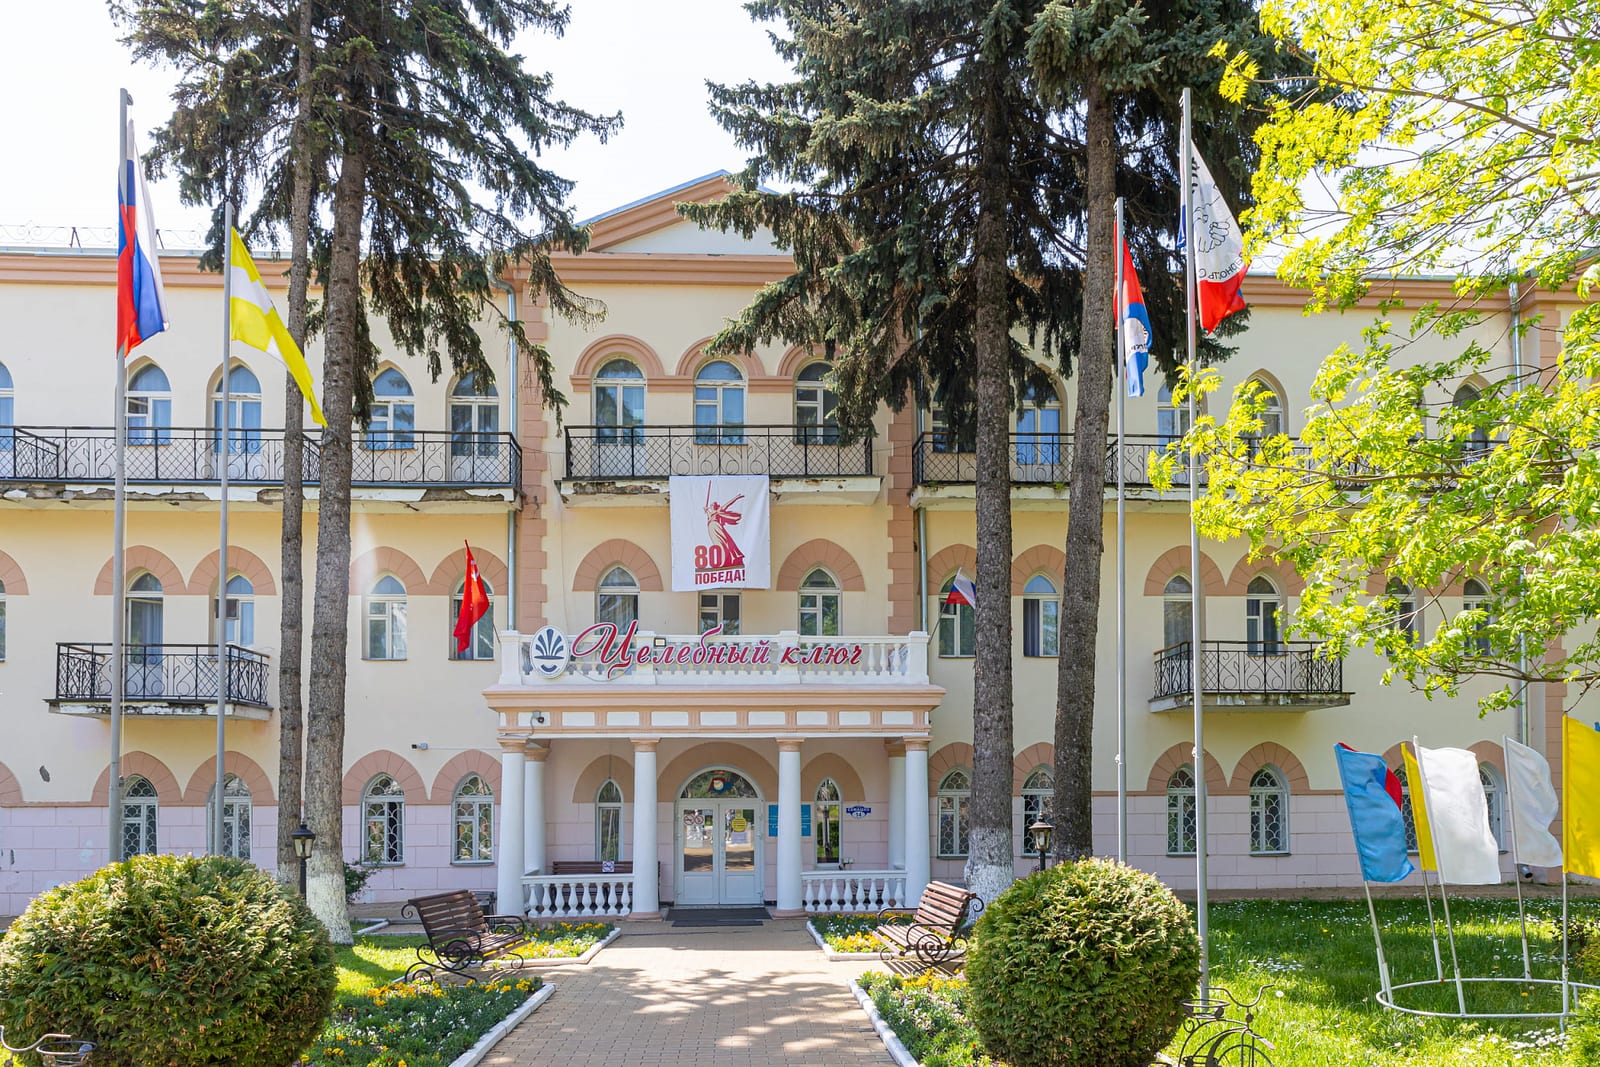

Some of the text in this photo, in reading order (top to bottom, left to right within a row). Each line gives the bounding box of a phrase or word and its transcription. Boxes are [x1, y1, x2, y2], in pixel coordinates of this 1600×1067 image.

[694, 544, 722, 569] 80
[694, 569, 746, 585] ПОБЕДА!
[571, 619, 863, 680] Целебный ключ
